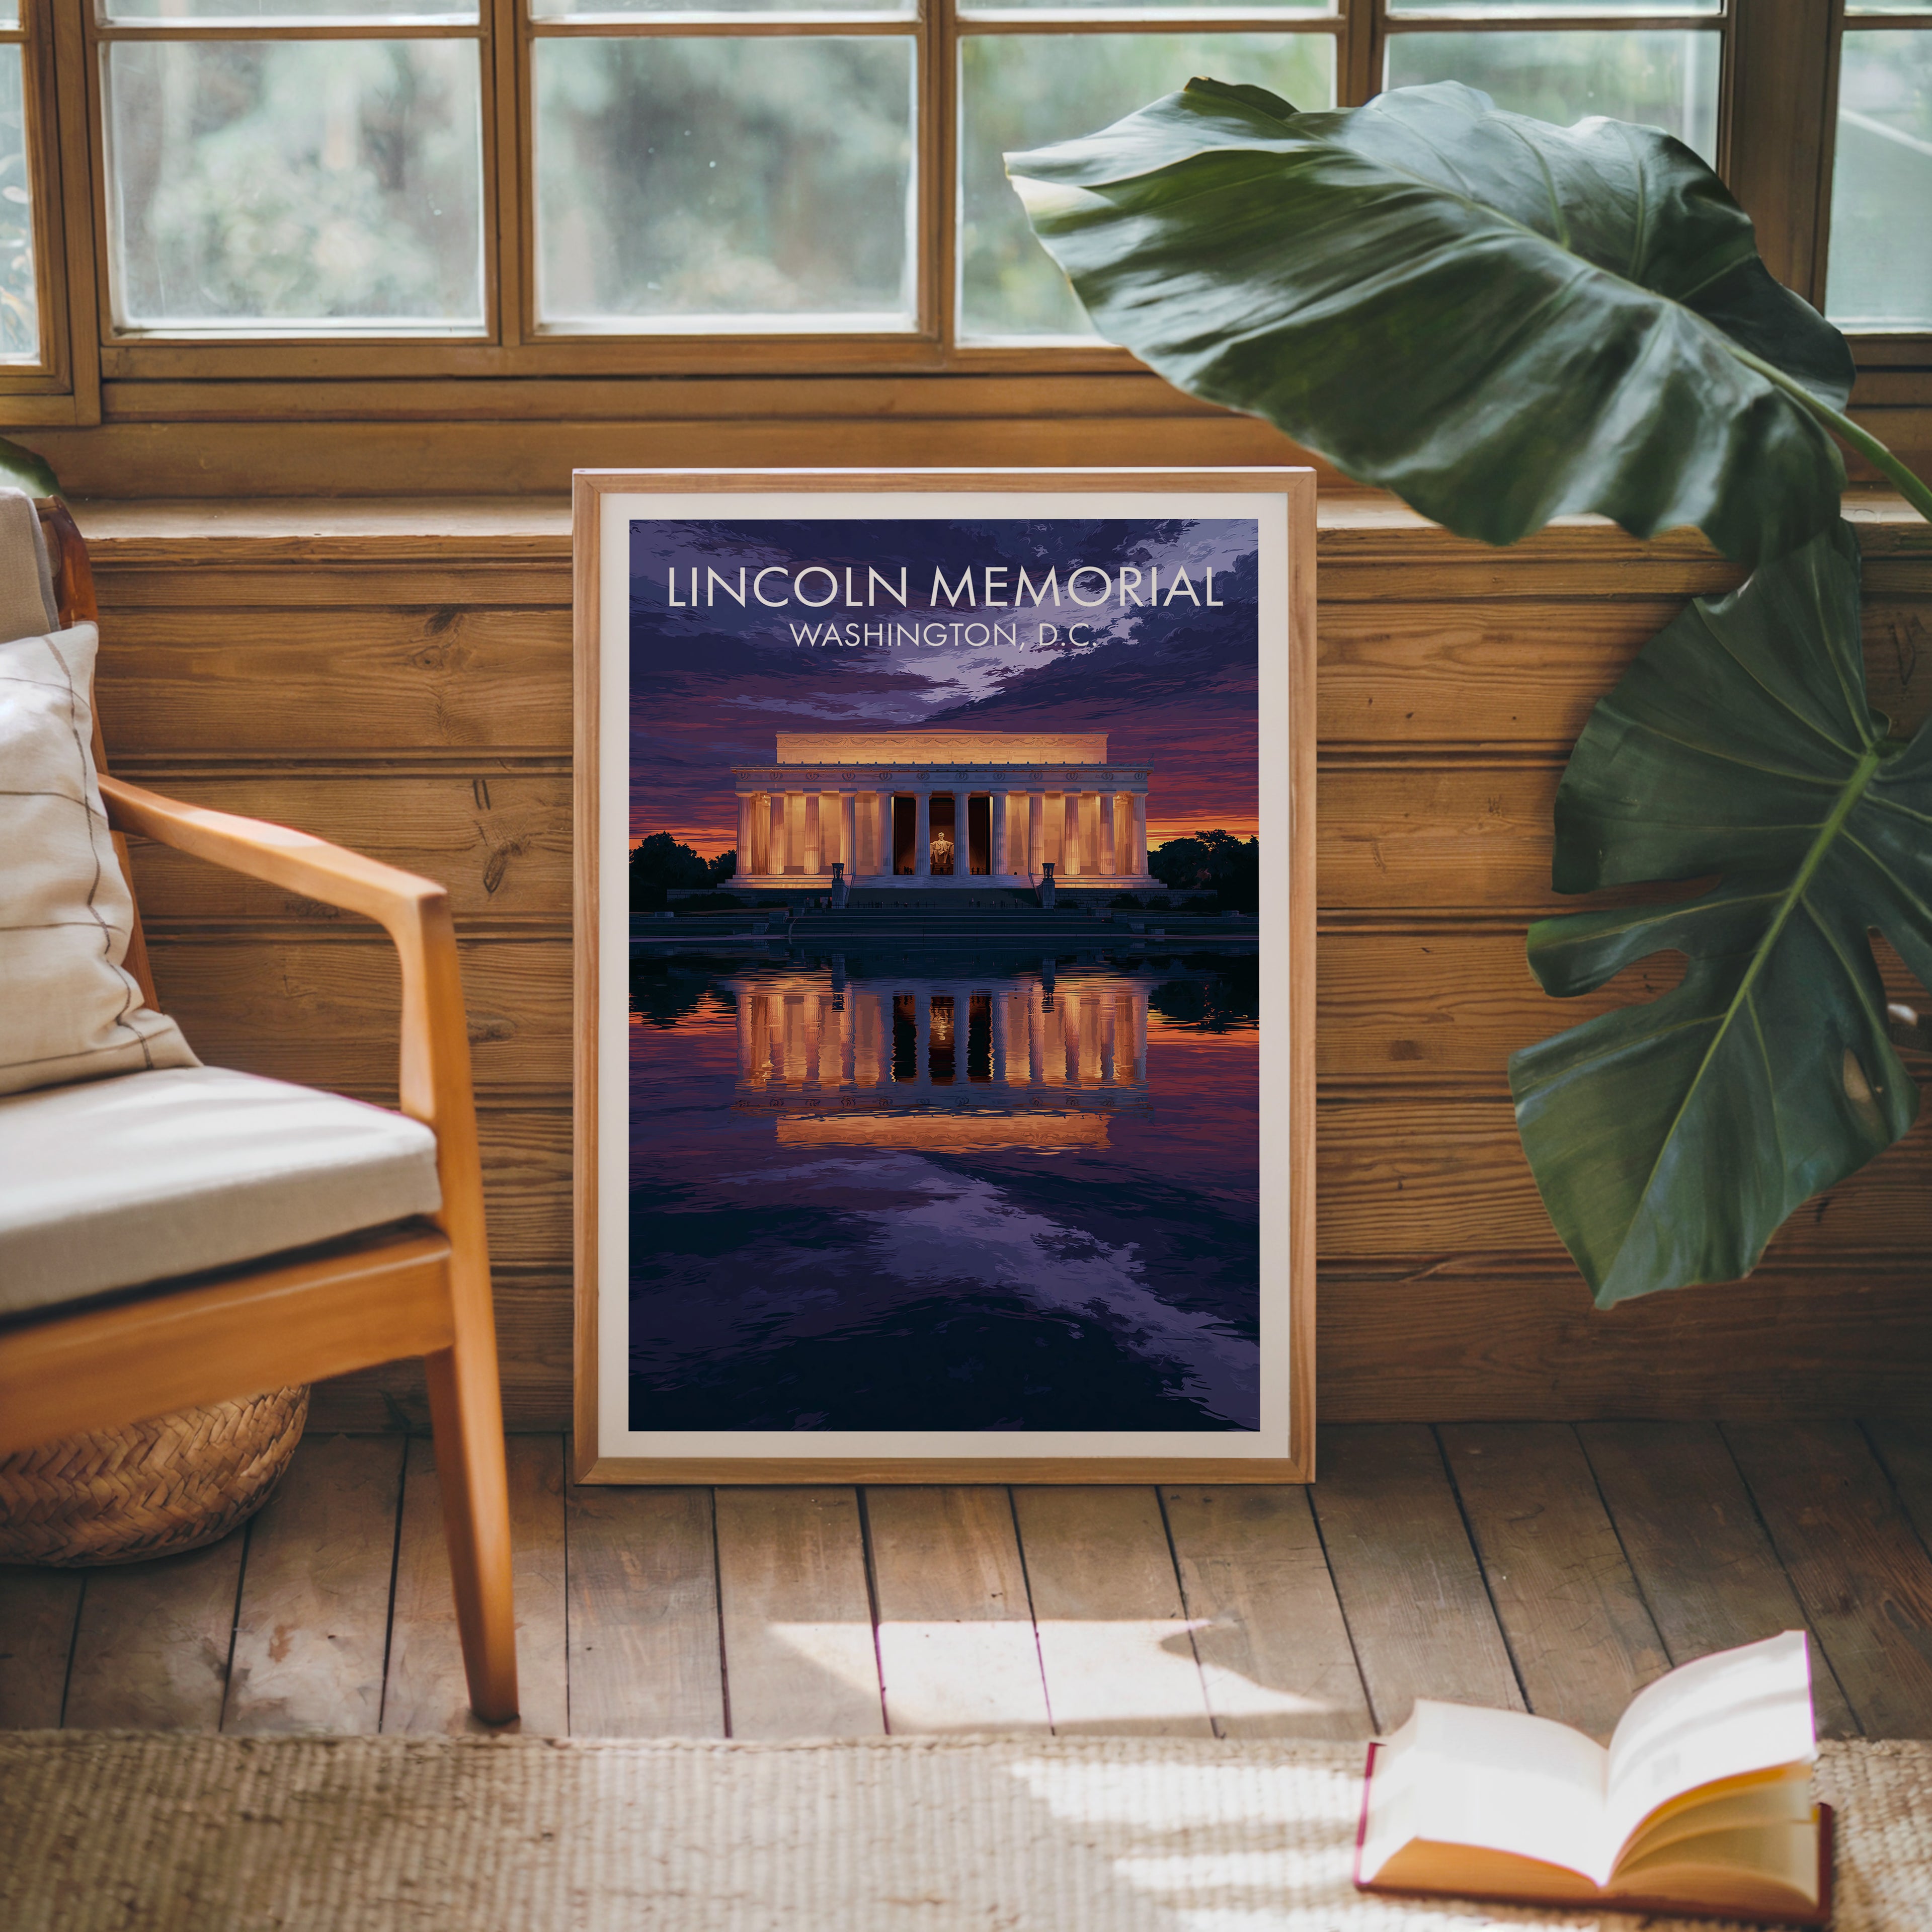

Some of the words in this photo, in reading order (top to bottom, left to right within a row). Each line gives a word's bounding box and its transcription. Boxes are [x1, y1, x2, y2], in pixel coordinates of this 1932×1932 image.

[669, 566, 907, 608] LINCOLN
[930, 566, 1224, 608] MEMORIAL
[789, 622, 1025, 651] WASHINGTON,
[1038, 622, 1098, 647] D.C.
